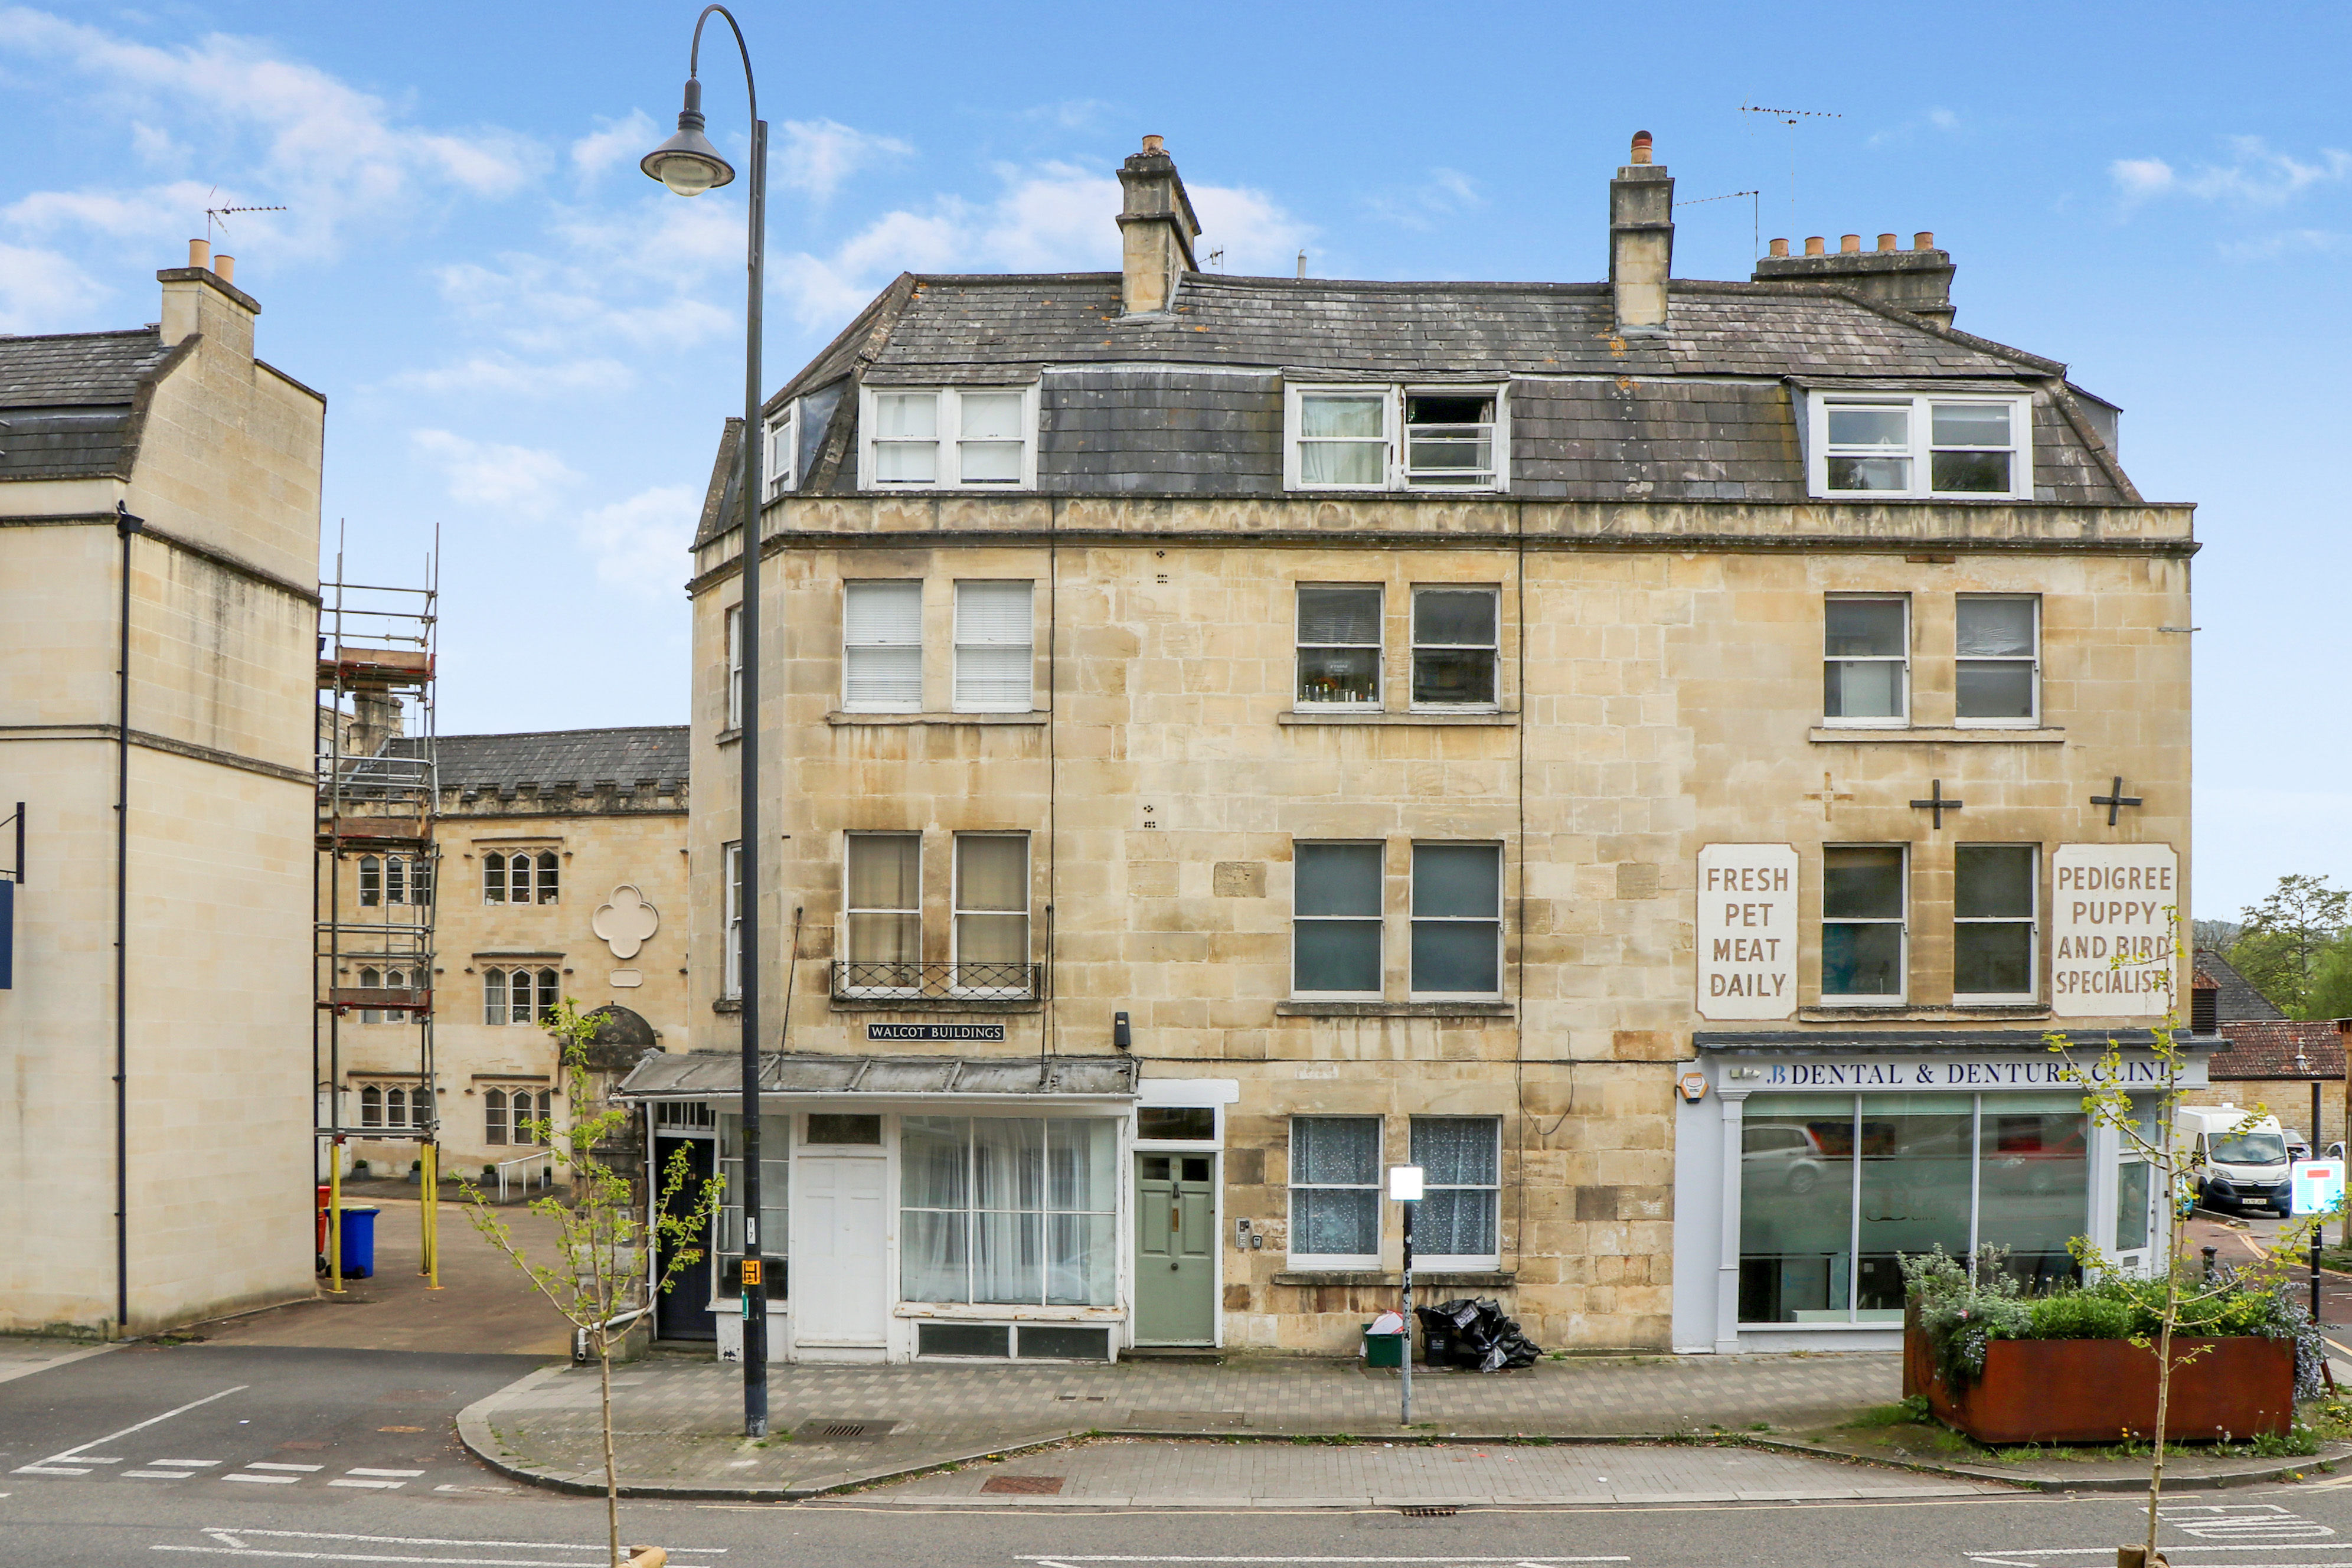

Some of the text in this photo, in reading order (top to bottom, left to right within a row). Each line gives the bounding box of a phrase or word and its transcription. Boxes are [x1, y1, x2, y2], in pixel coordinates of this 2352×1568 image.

[1707, 868, 1788, 891] FRESH
[2059, 867, 2171, 890] PEDIGREE
[1726, 903, 1773, 926] PET
[2073, 901, 2157, 925] PUPPY
[1714, 939, 1781, 962] MEAT
[2057, 936, 2169, 959] AND BIRD
[1711, 974, 1786, 997] DAILY
[871, 1027, 1001, 1038] WALCOT BUILDINGS
[1791, 1064, 1903, 1084] DENTAL
[1916, 1063, 1934, 1084] &
[1947, 1063, 2079, 1084] DENTURE
[744, 1263, 757, 1282] H
